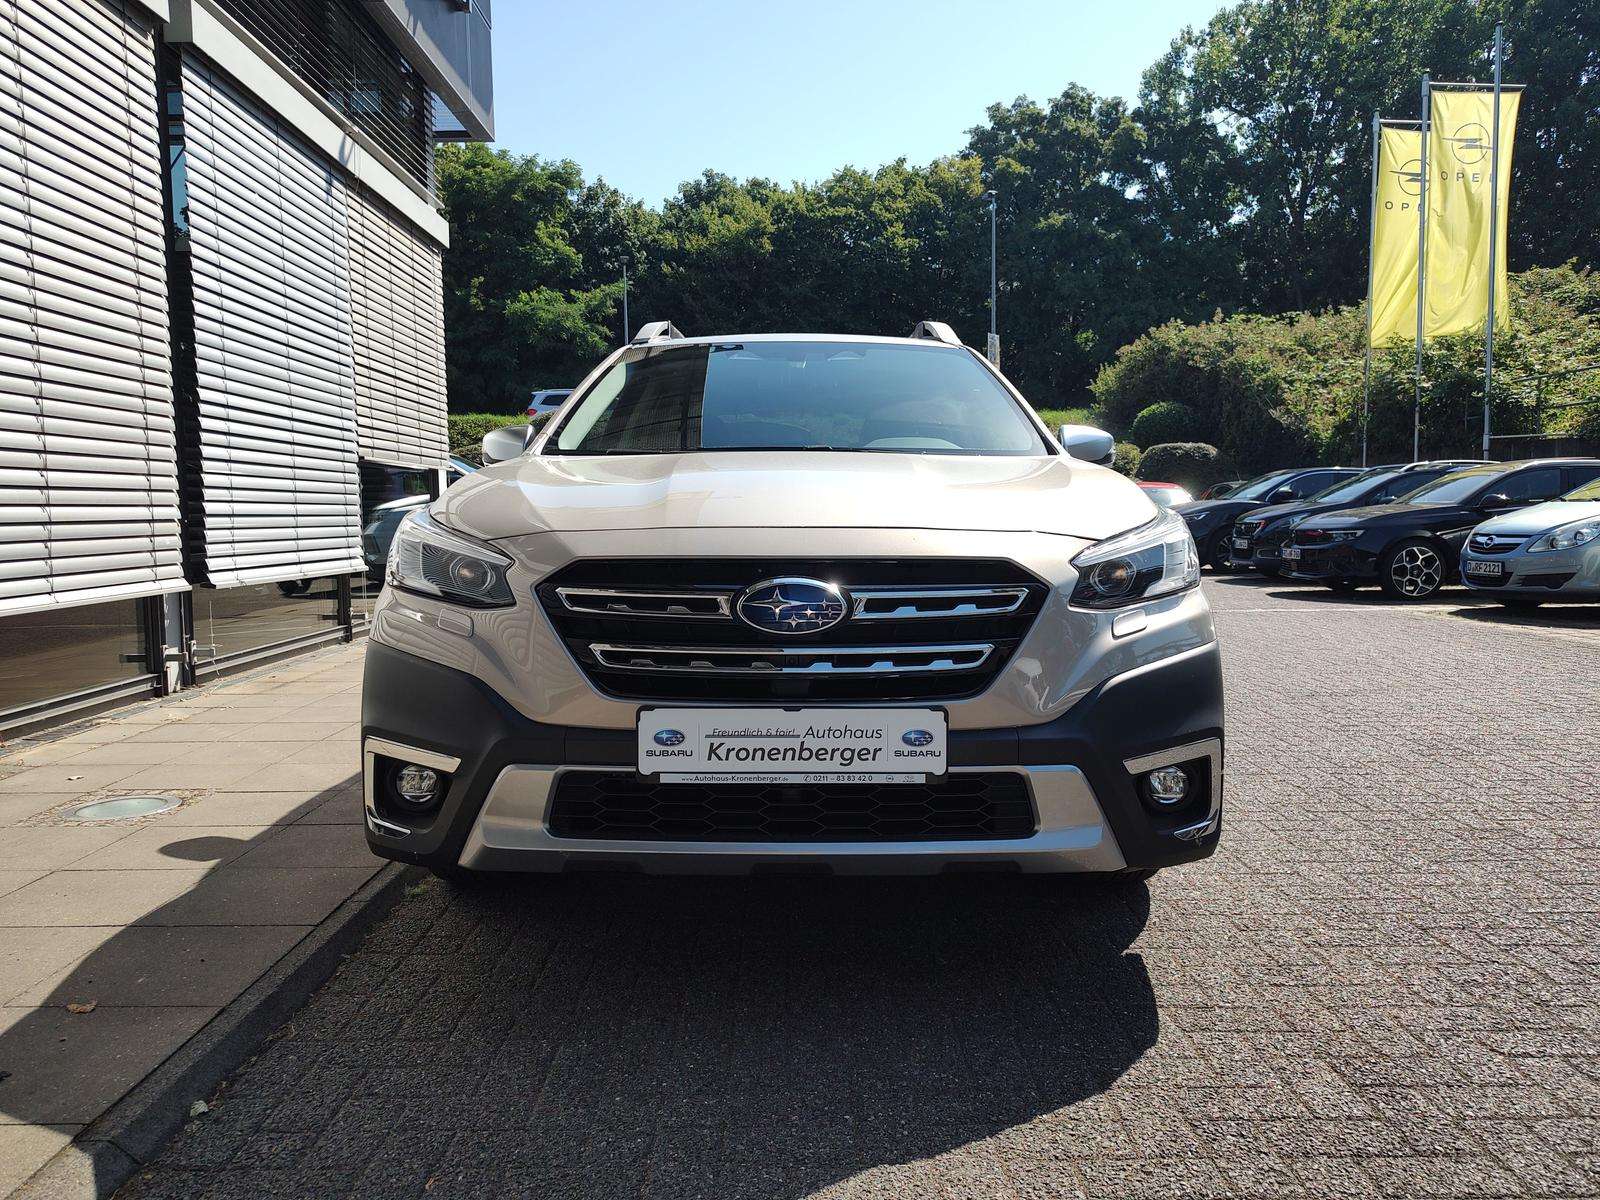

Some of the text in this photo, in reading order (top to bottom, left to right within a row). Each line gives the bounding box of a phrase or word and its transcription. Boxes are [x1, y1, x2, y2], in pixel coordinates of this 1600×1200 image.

[1483, 562, 1500, 573] 2121
[712, 727, 796, 737] Freundlich & fair!
[803, 724, 883, 739] Autohaus
[645, 749, 693, 757] SUBARU
[706, 741, 882, 767] Kronenberger
[893, 750, 942, 758] SUBARU
[681, 775, 789, 783] www.Autohaus-Kronenberger.de
